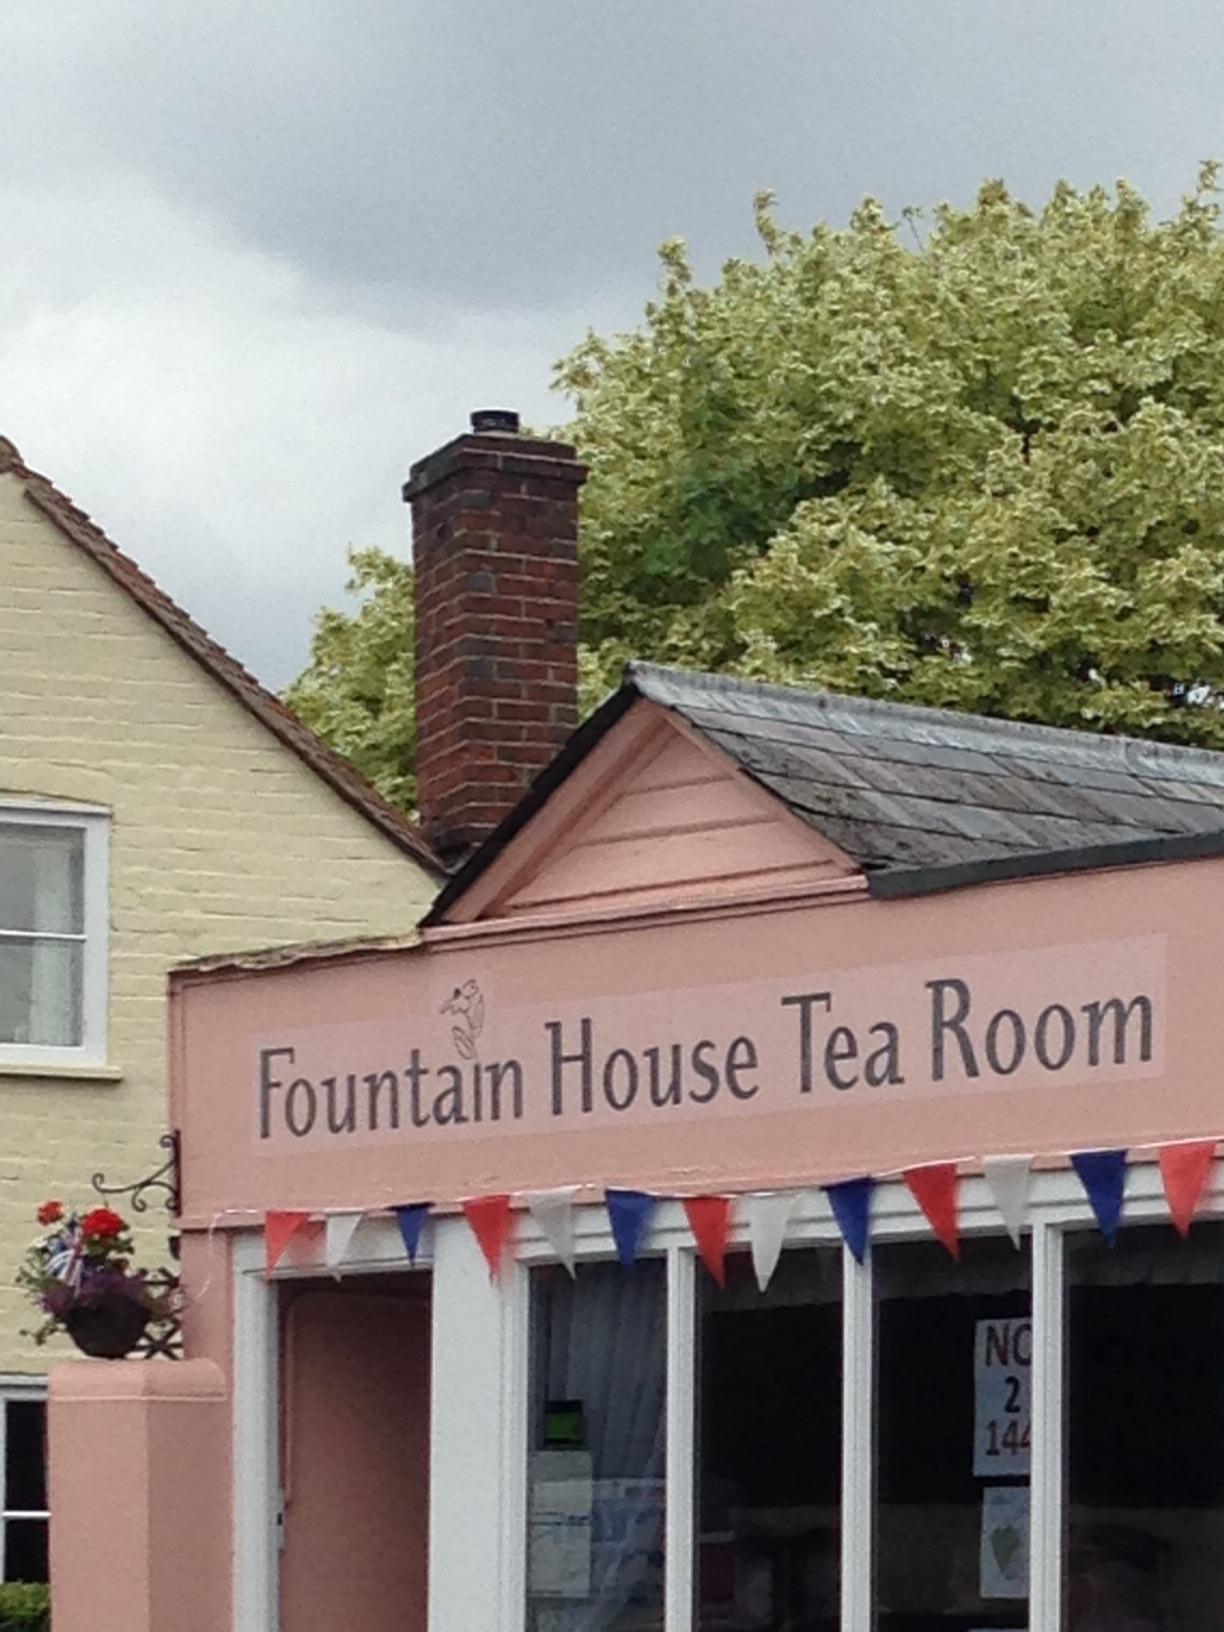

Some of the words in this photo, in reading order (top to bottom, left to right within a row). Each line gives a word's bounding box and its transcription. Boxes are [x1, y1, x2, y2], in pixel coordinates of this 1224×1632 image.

[259, 1047, 523, 1140] Fountain
[545, 1017, 760, 1117] House
[781, 992, 905, 1093] Tea
[925, 977, 1154, 1082] Room
[1005, 1375, 1021, 1413] 2
